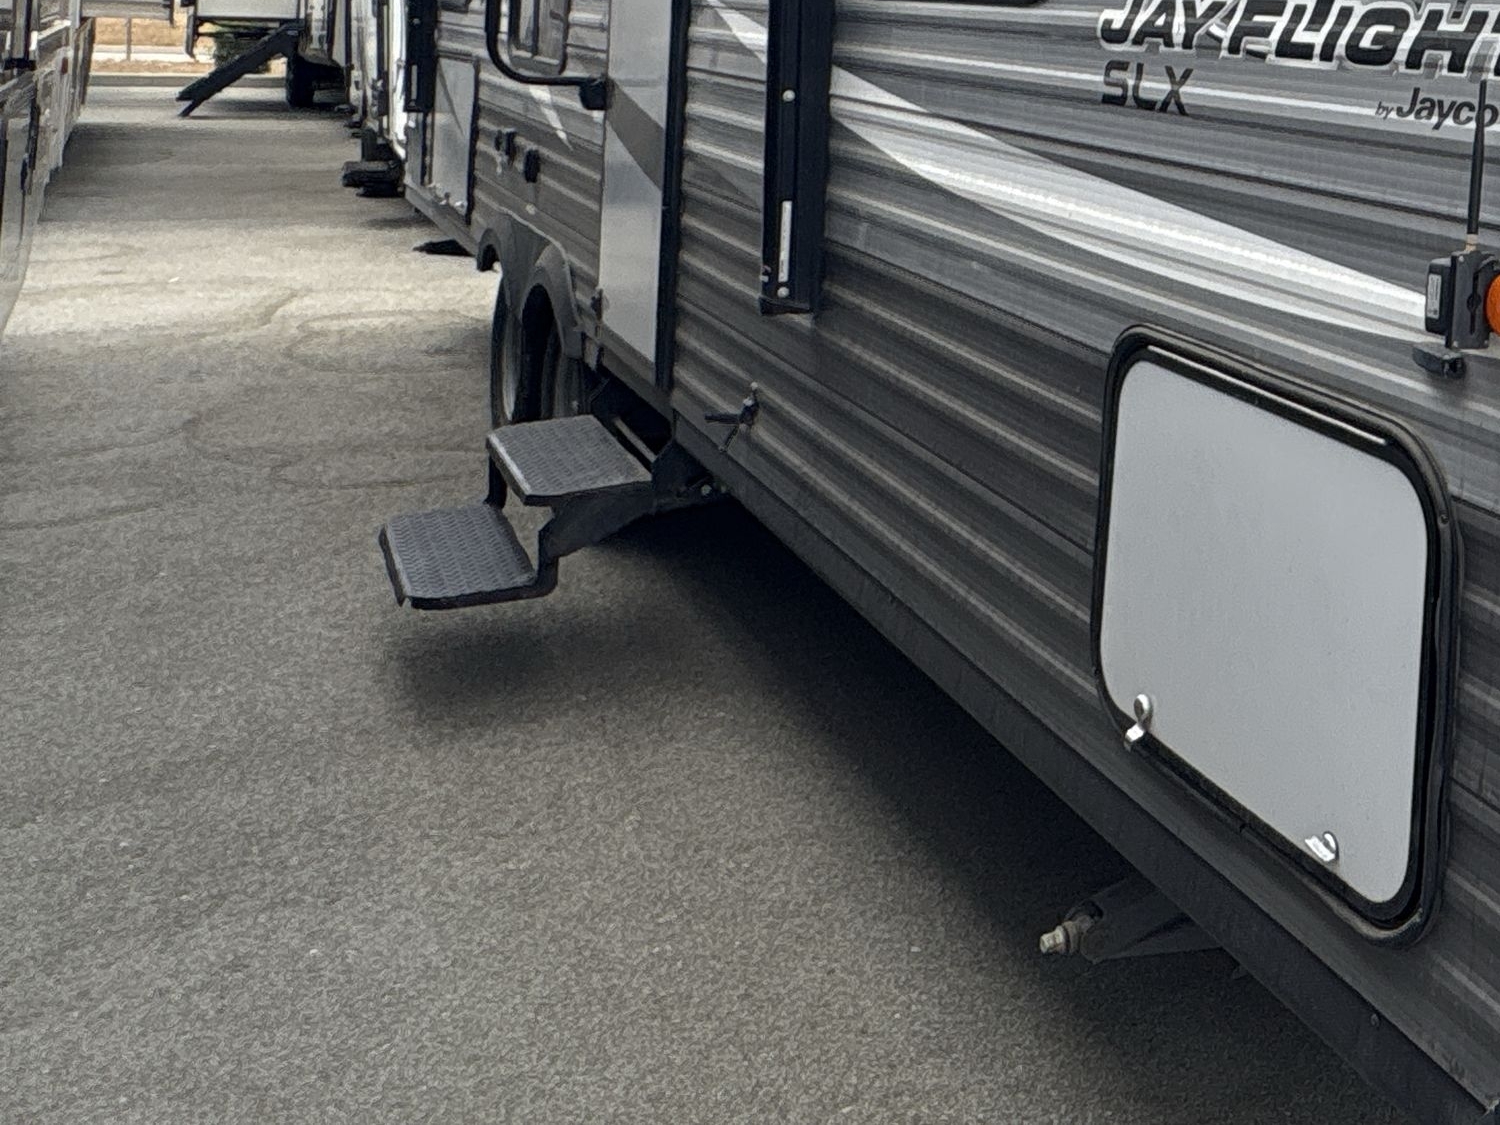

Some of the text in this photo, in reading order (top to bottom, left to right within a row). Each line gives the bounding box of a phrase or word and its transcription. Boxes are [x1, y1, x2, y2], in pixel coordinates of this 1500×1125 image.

[1101, 59, 1194, 117] SLX
[1374, 87, 1500, 130] by Jayco
